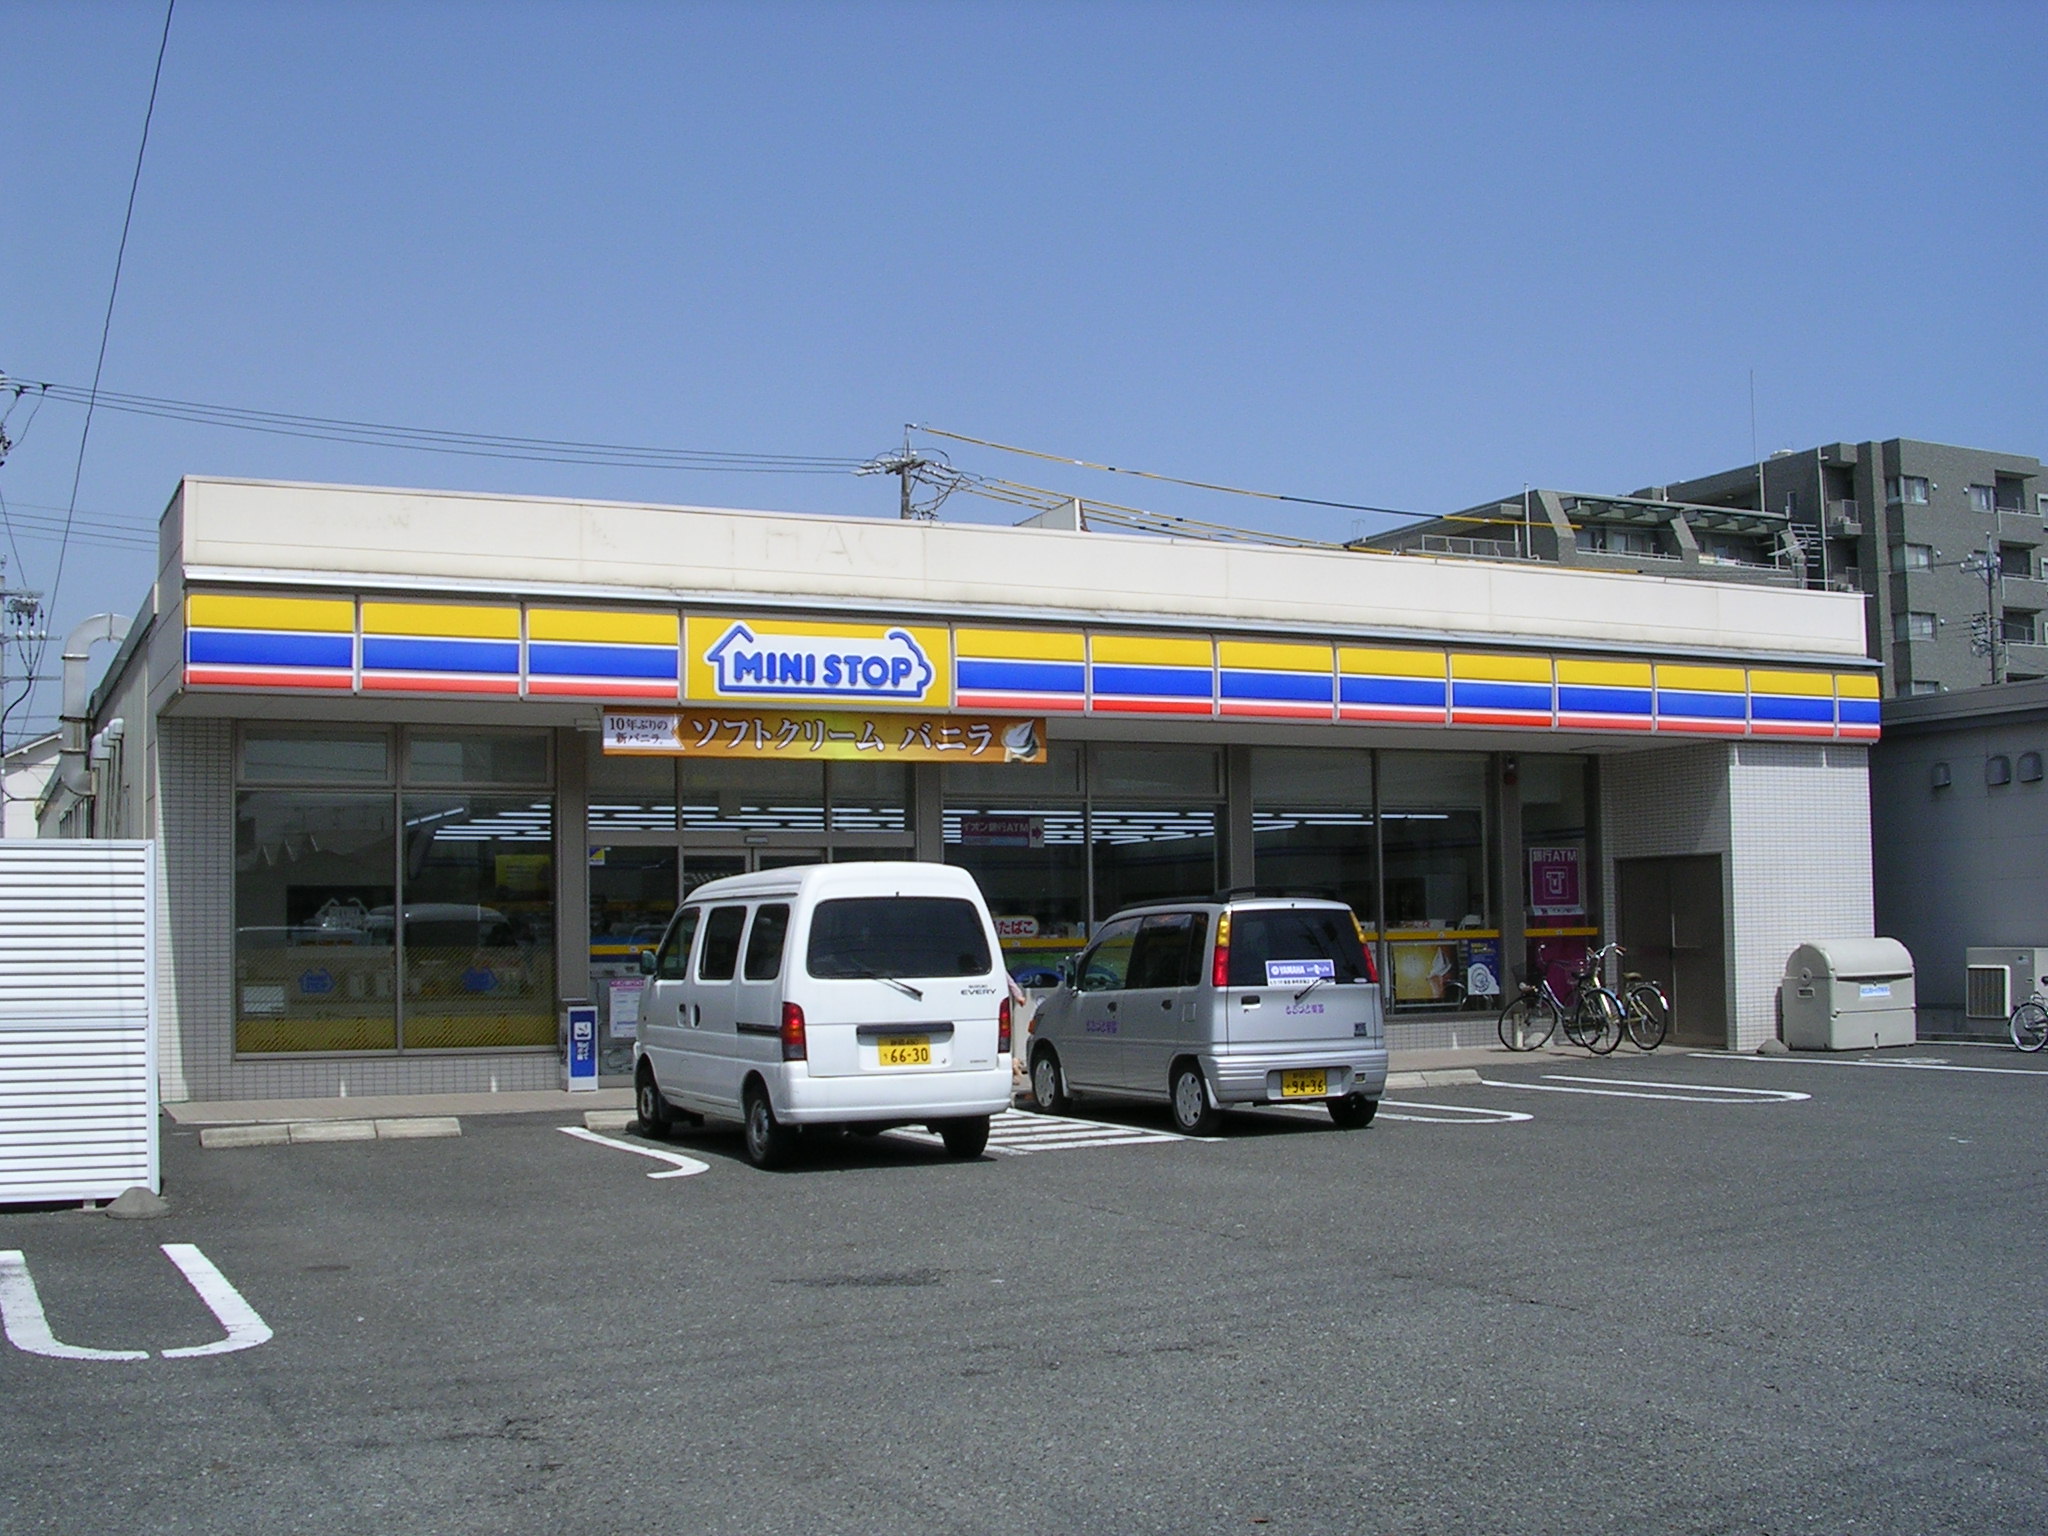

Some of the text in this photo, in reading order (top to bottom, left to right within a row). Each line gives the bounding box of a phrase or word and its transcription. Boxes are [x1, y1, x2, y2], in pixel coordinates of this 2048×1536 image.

[733, 651, 913, 687] MINI STOP
[608, 716, 668, 732] 10年ぶりの
[692, 717, 993, 756] ソフトクリーム バニラ
[993, 919, 1033, 935] たばこ
[960, 988, 997, 996] EVERY
[890, 1046, 929, 1063] 66-30
[1291, 1078, 1324, 1094] 94-36
